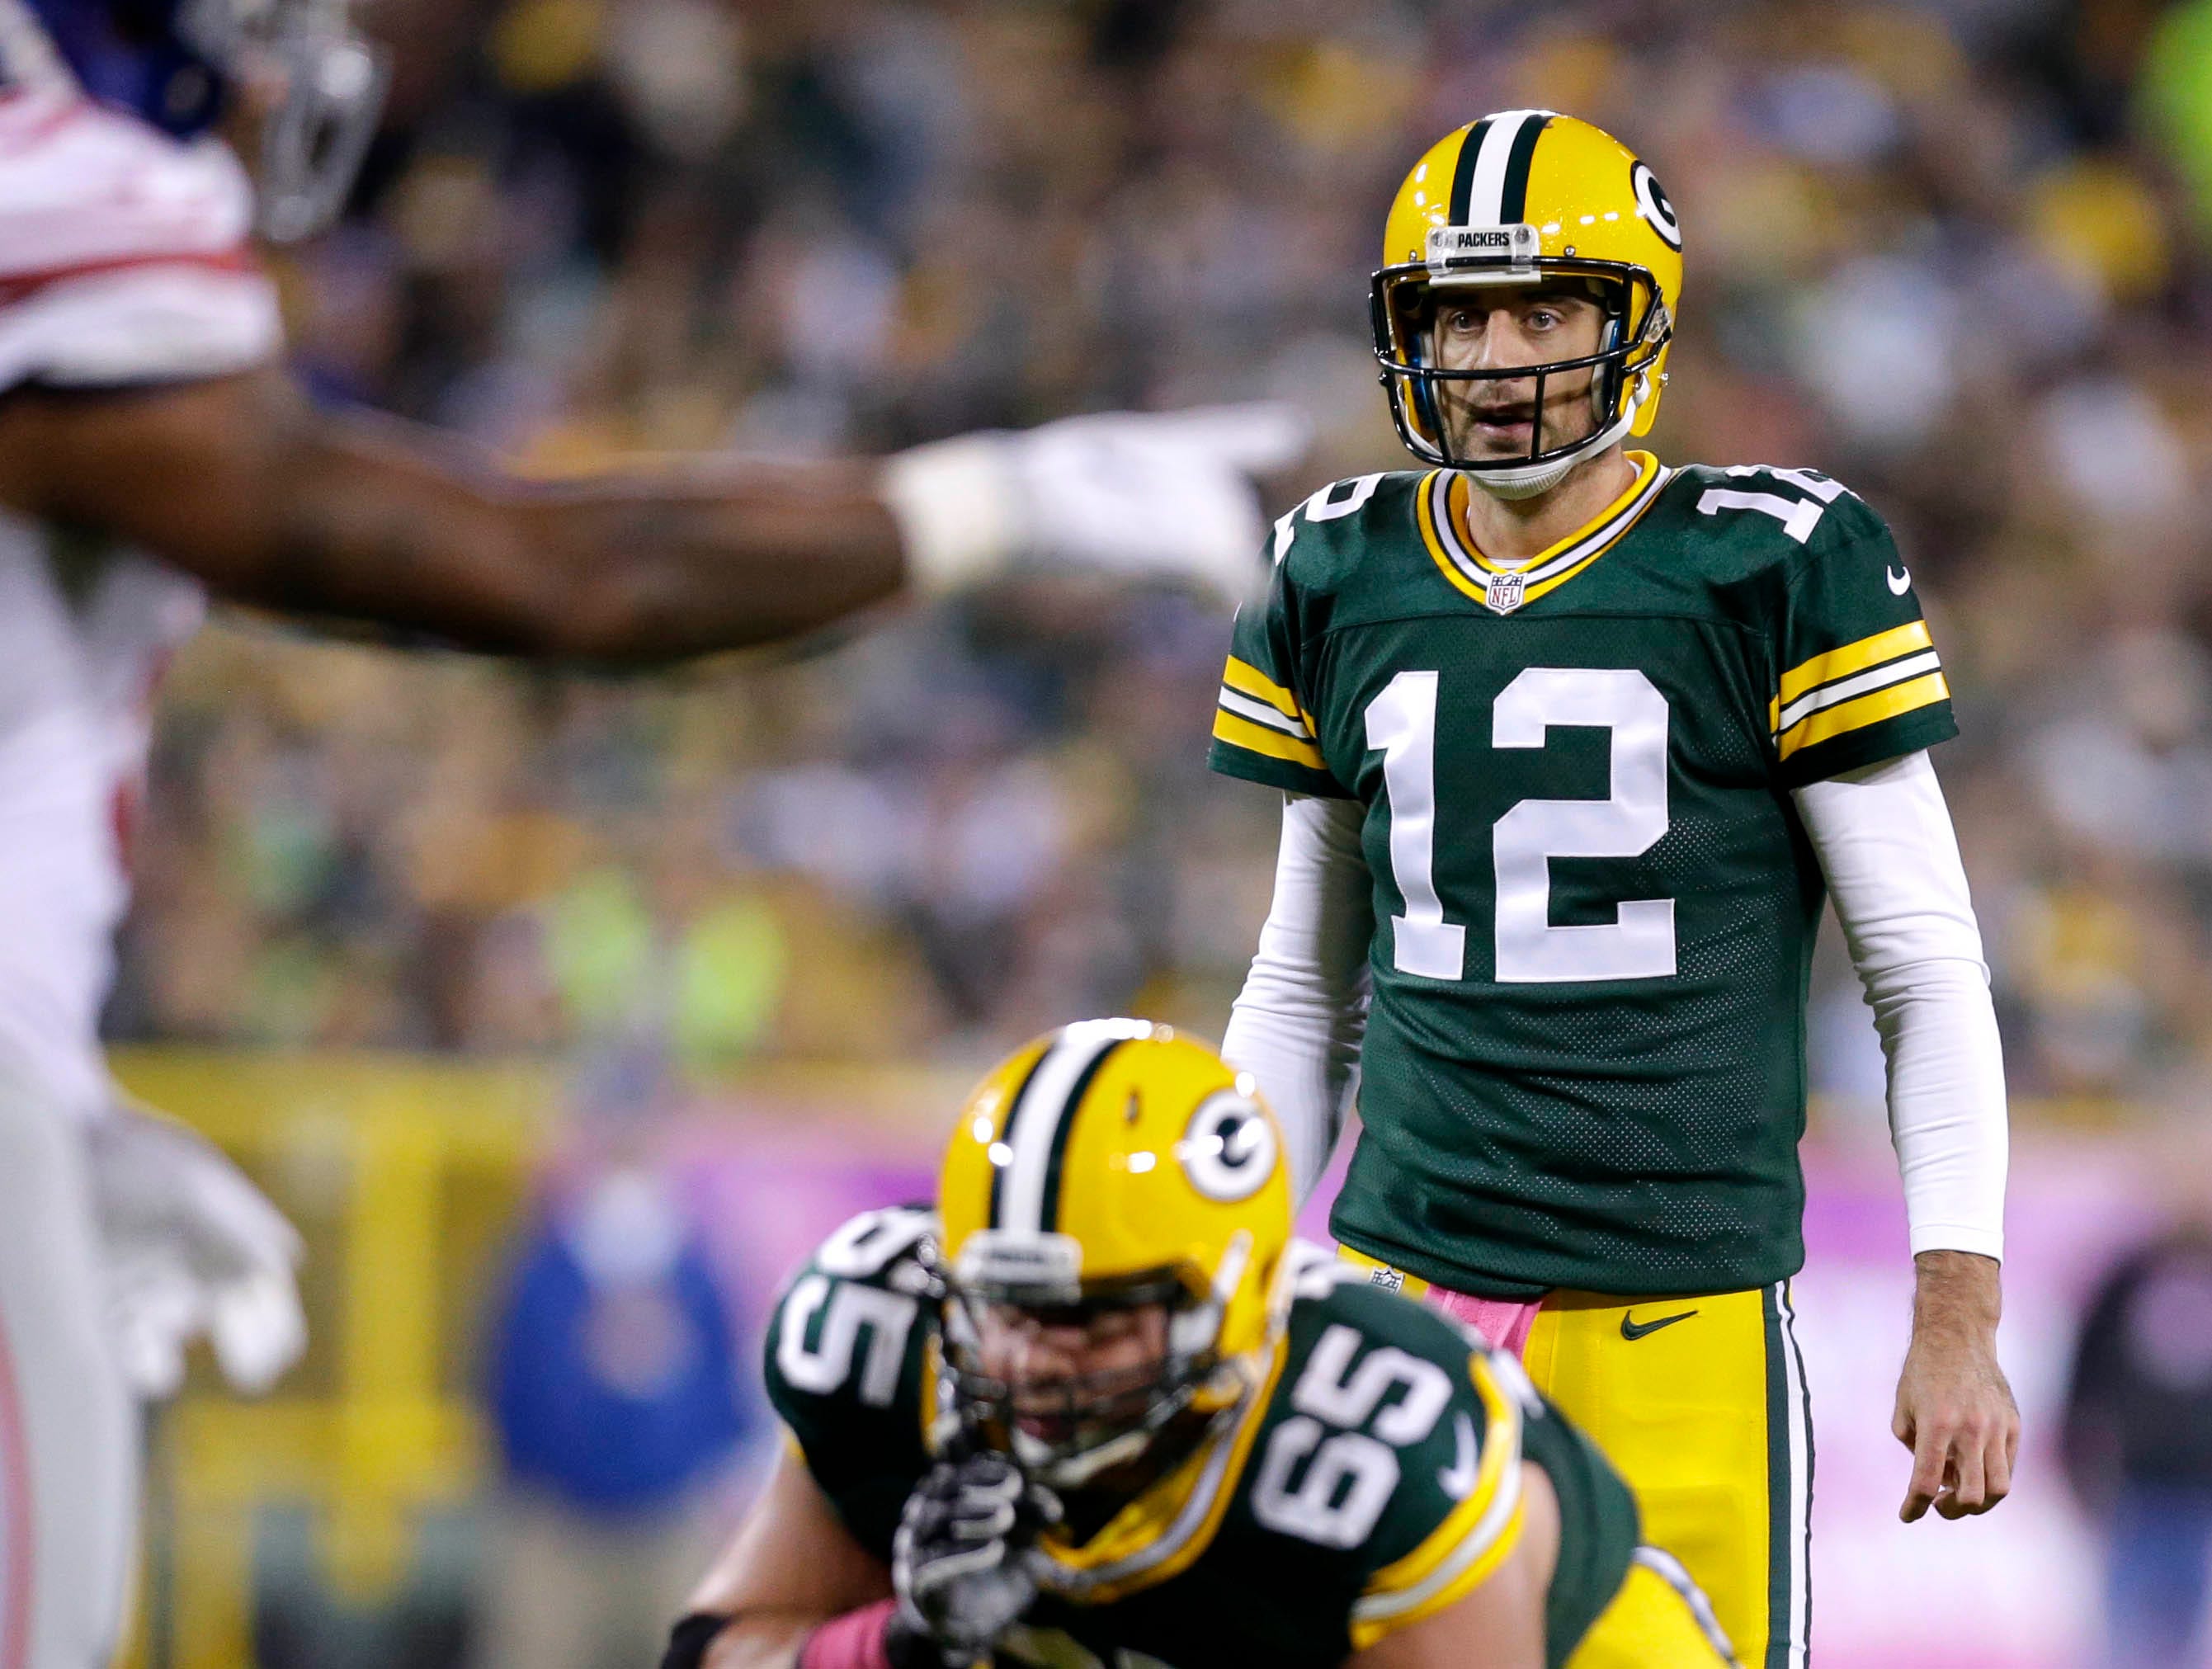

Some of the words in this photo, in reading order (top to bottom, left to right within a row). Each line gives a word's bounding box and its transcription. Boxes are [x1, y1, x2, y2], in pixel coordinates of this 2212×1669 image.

[1458, 232, 1510, 248] PACKERS
[1492, 587, 1516, 606] NFL
[1365, 667, 1677, 982] 12
[1251, 1323, 1455, 1550] 65
